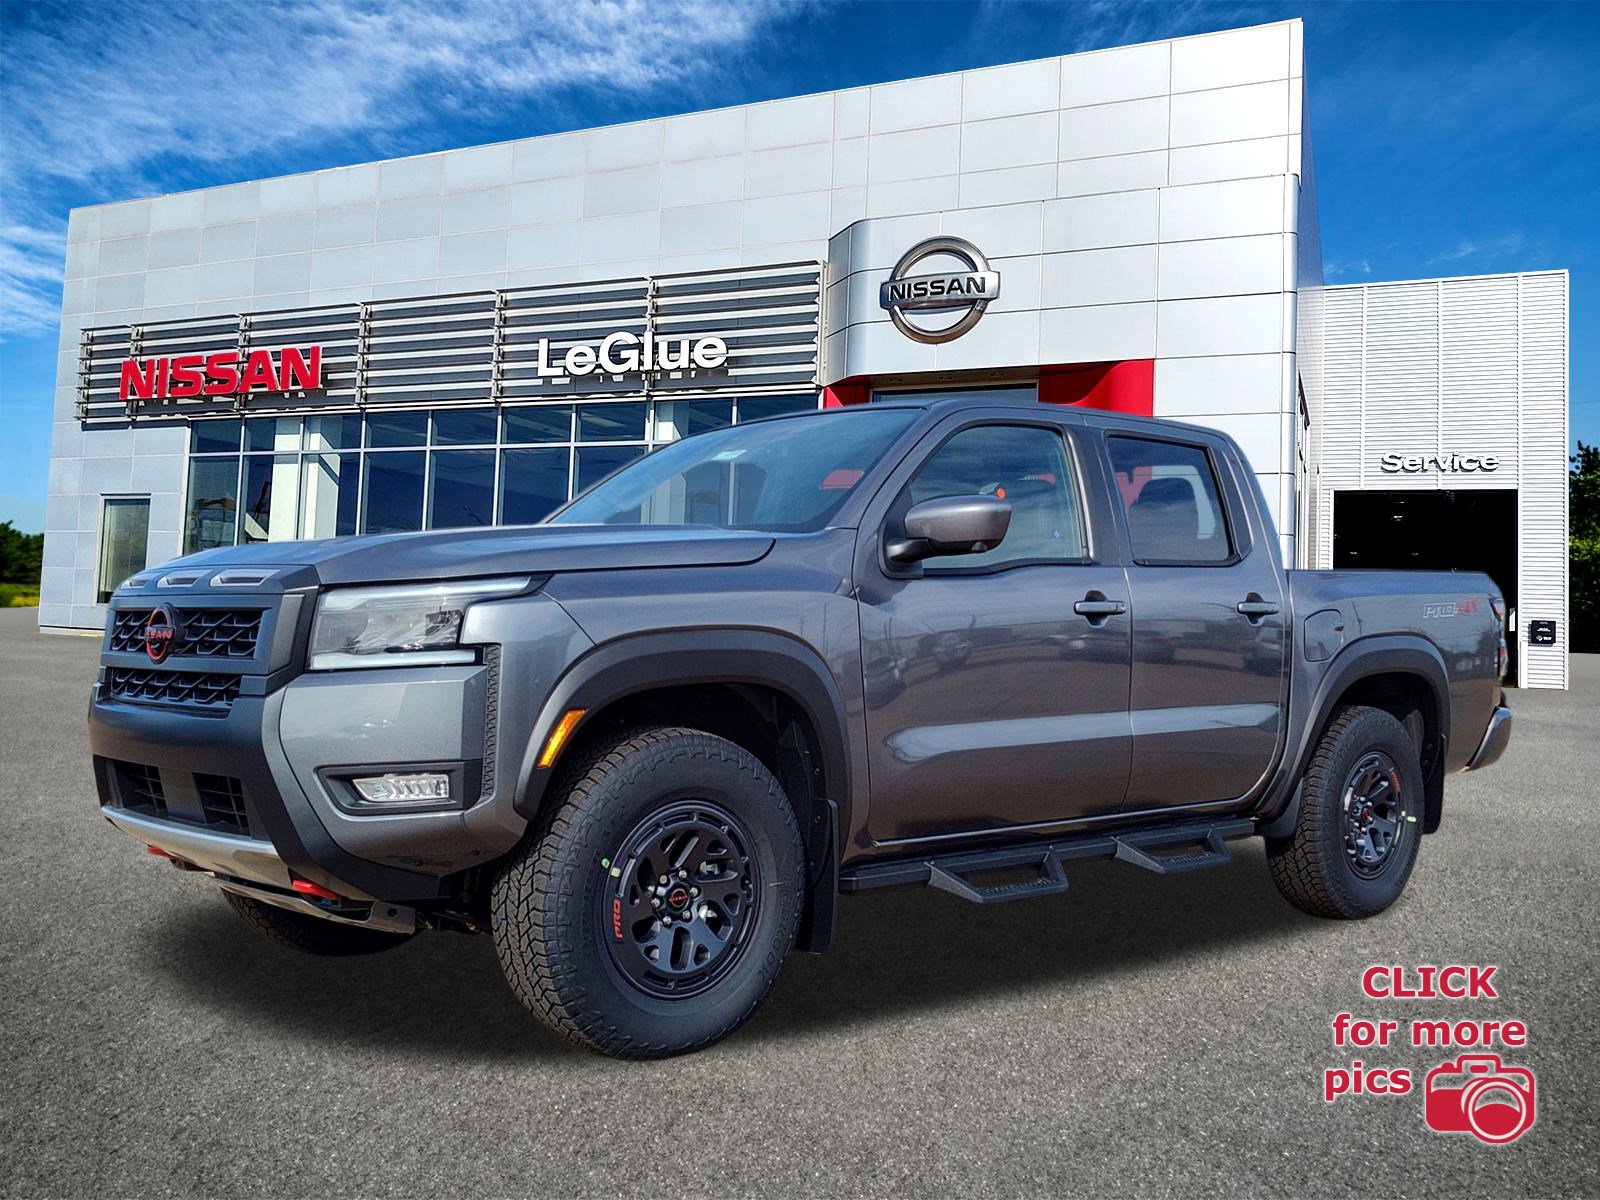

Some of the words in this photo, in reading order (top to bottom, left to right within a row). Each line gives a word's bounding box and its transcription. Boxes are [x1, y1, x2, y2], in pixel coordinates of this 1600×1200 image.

[888, 276, 986, 301] NISSAN
[537, 331, 728, 377] LeGlue
[119, 345, 323, 400] NISSAN
[1381, 451, 1500, 473] Service
